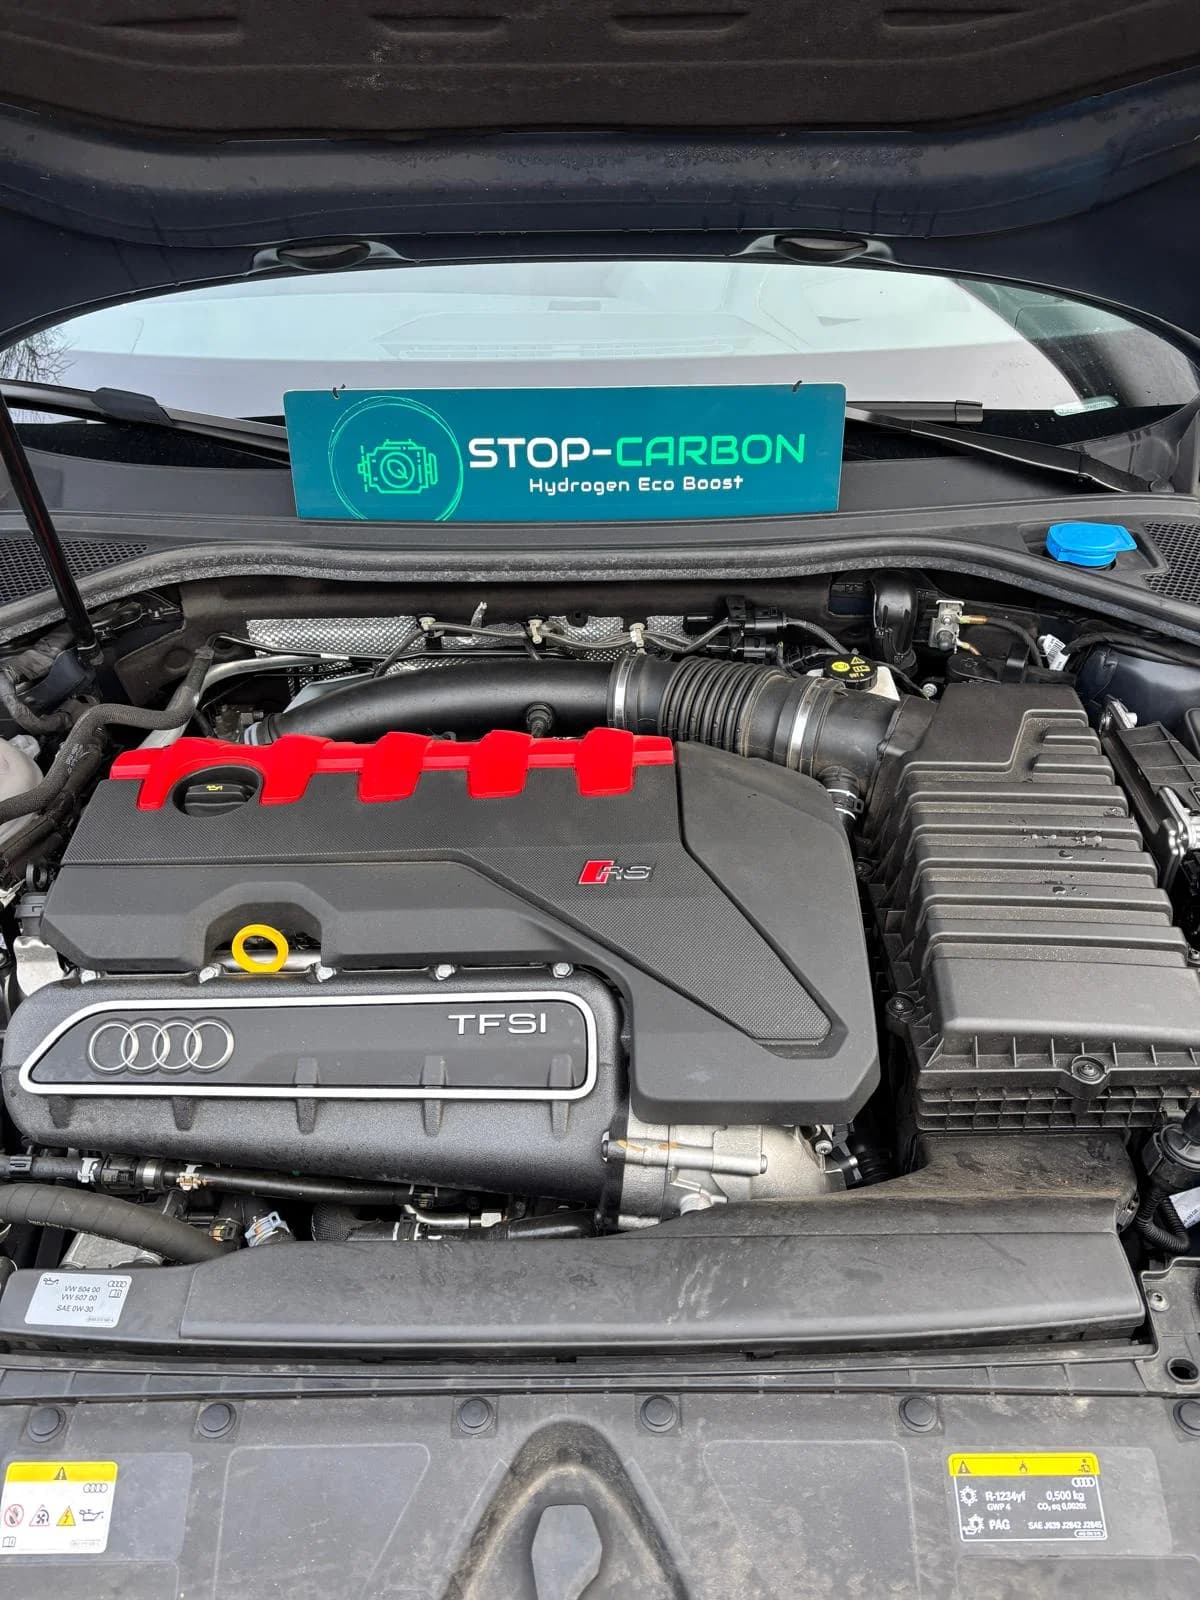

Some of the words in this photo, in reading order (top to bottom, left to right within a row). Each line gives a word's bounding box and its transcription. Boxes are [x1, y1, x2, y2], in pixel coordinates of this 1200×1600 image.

[468, 433, 806, 469] STOP-CARBON
[529, 476, 630, 495] Hydrogen
[638, 476, 675, 492] Eco
[683, 474, 744, 490] Boost
[595, 865, 652, 880] RS
[447, 1012, 547, 1035] TFSI
[56, 1304, 71, 1312] SAE
[985, 1490, 1026, 1503] R-1234yf
[1046, 1490, 1072, 1501] 0,500
[1073, 1490, 1085, 1502] kg
[987, 1503, 1005, 1511] GWP
[988, 1520, 1010, 1530] PAG
[1028, 1521, 1043, 1530] SAE
